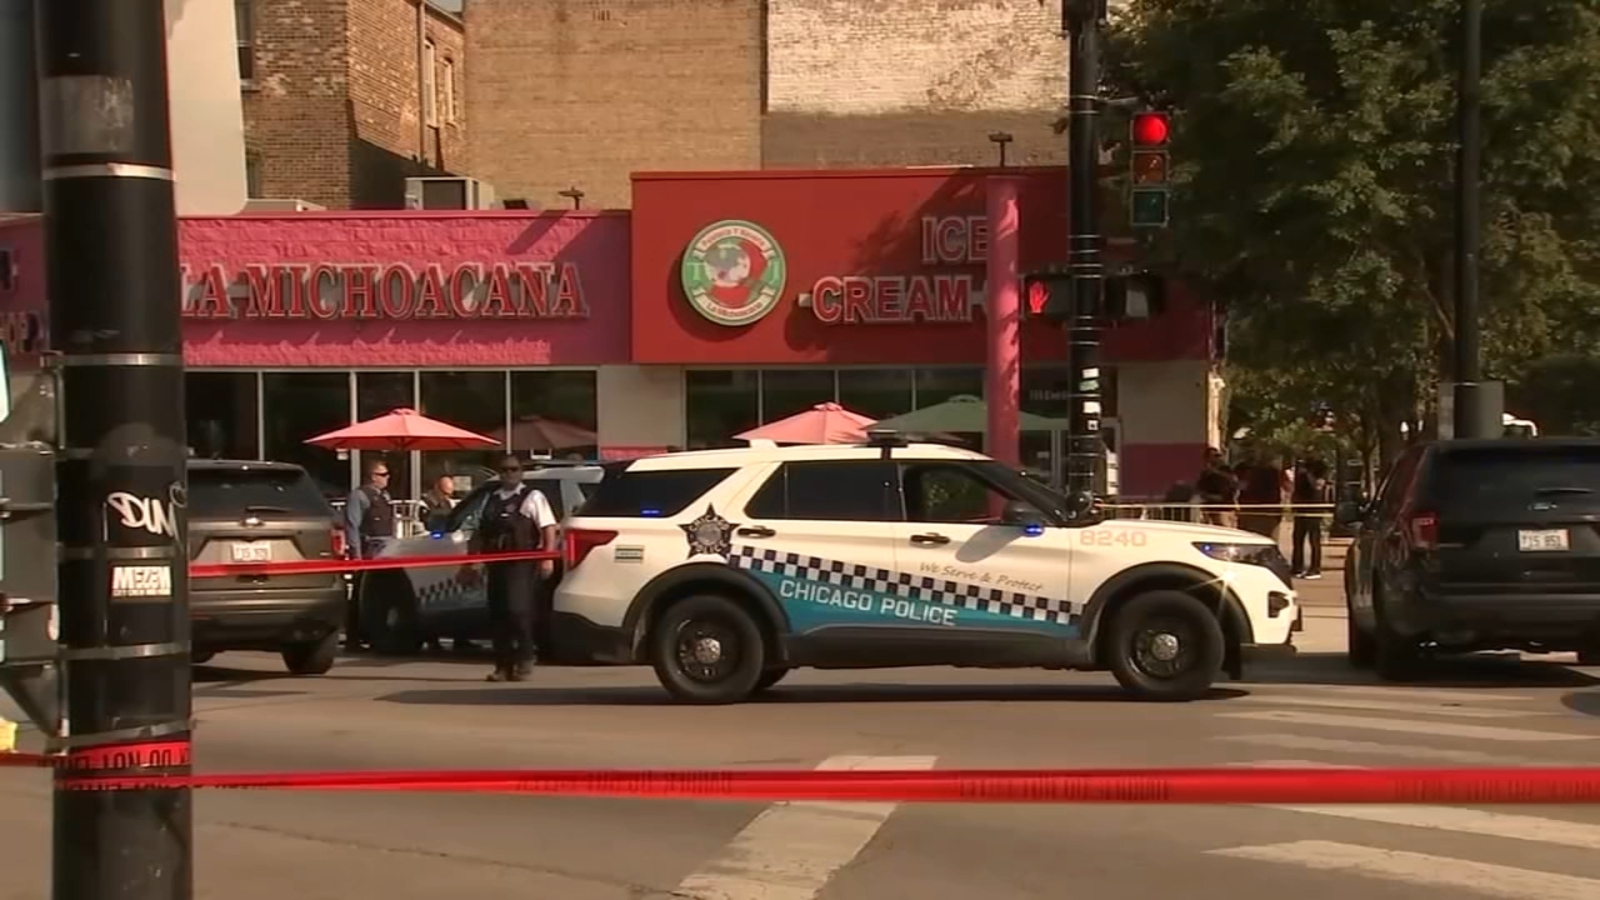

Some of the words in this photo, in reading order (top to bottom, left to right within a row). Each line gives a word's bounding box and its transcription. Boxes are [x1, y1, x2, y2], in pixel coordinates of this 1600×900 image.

[245, 261, 590, 319] MICHOACANA
[812, 275, 972, 322] CREAM
[1080, 529, 1147, 548] 8240
[920, 562, 940, 573] We
[941, 565, 979, 580] Serve
[980, 572, 992, 583] &
[995, 575, 1044, 591] Protect
[779, 579, 873, 612] CHICAGO
[879, 597, 959, 627] POLICE
